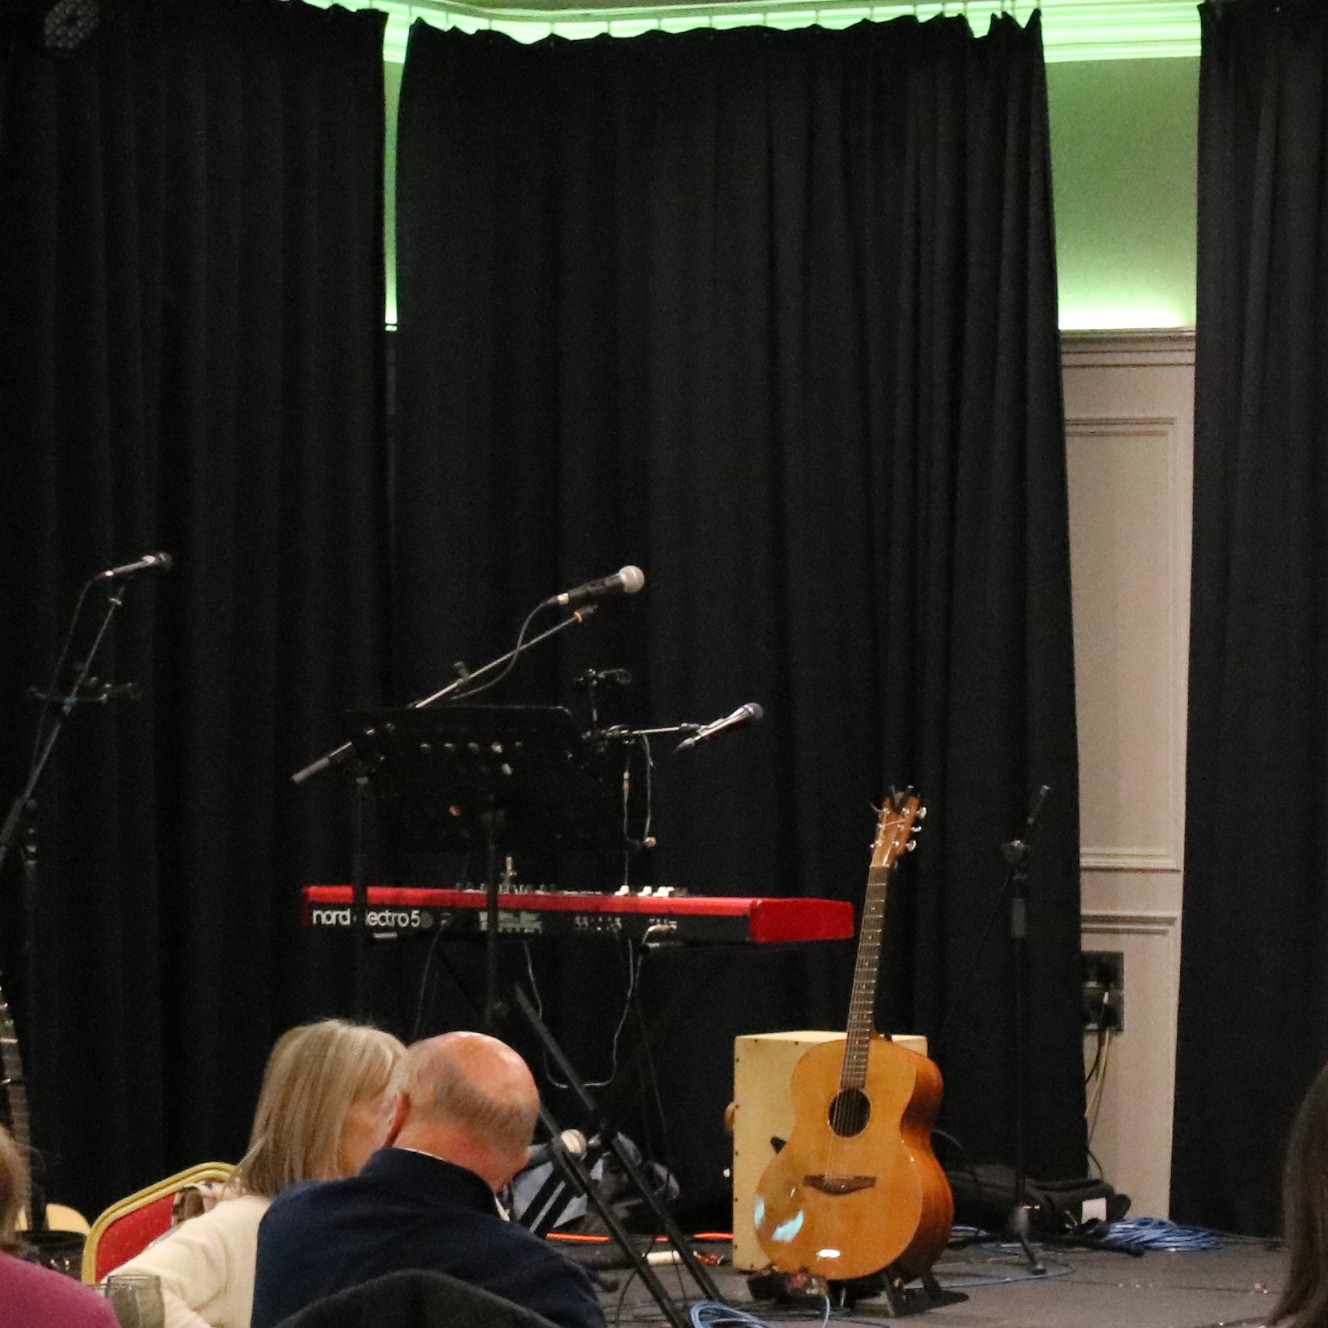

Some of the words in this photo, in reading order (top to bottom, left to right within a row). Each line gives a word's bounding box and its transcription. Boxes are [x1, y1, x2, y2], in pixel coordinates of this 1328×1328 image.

[312, 908, 351, 926] nord
[353, 909, 409, 927] lectro
[410, 910, 421, 927] 5
